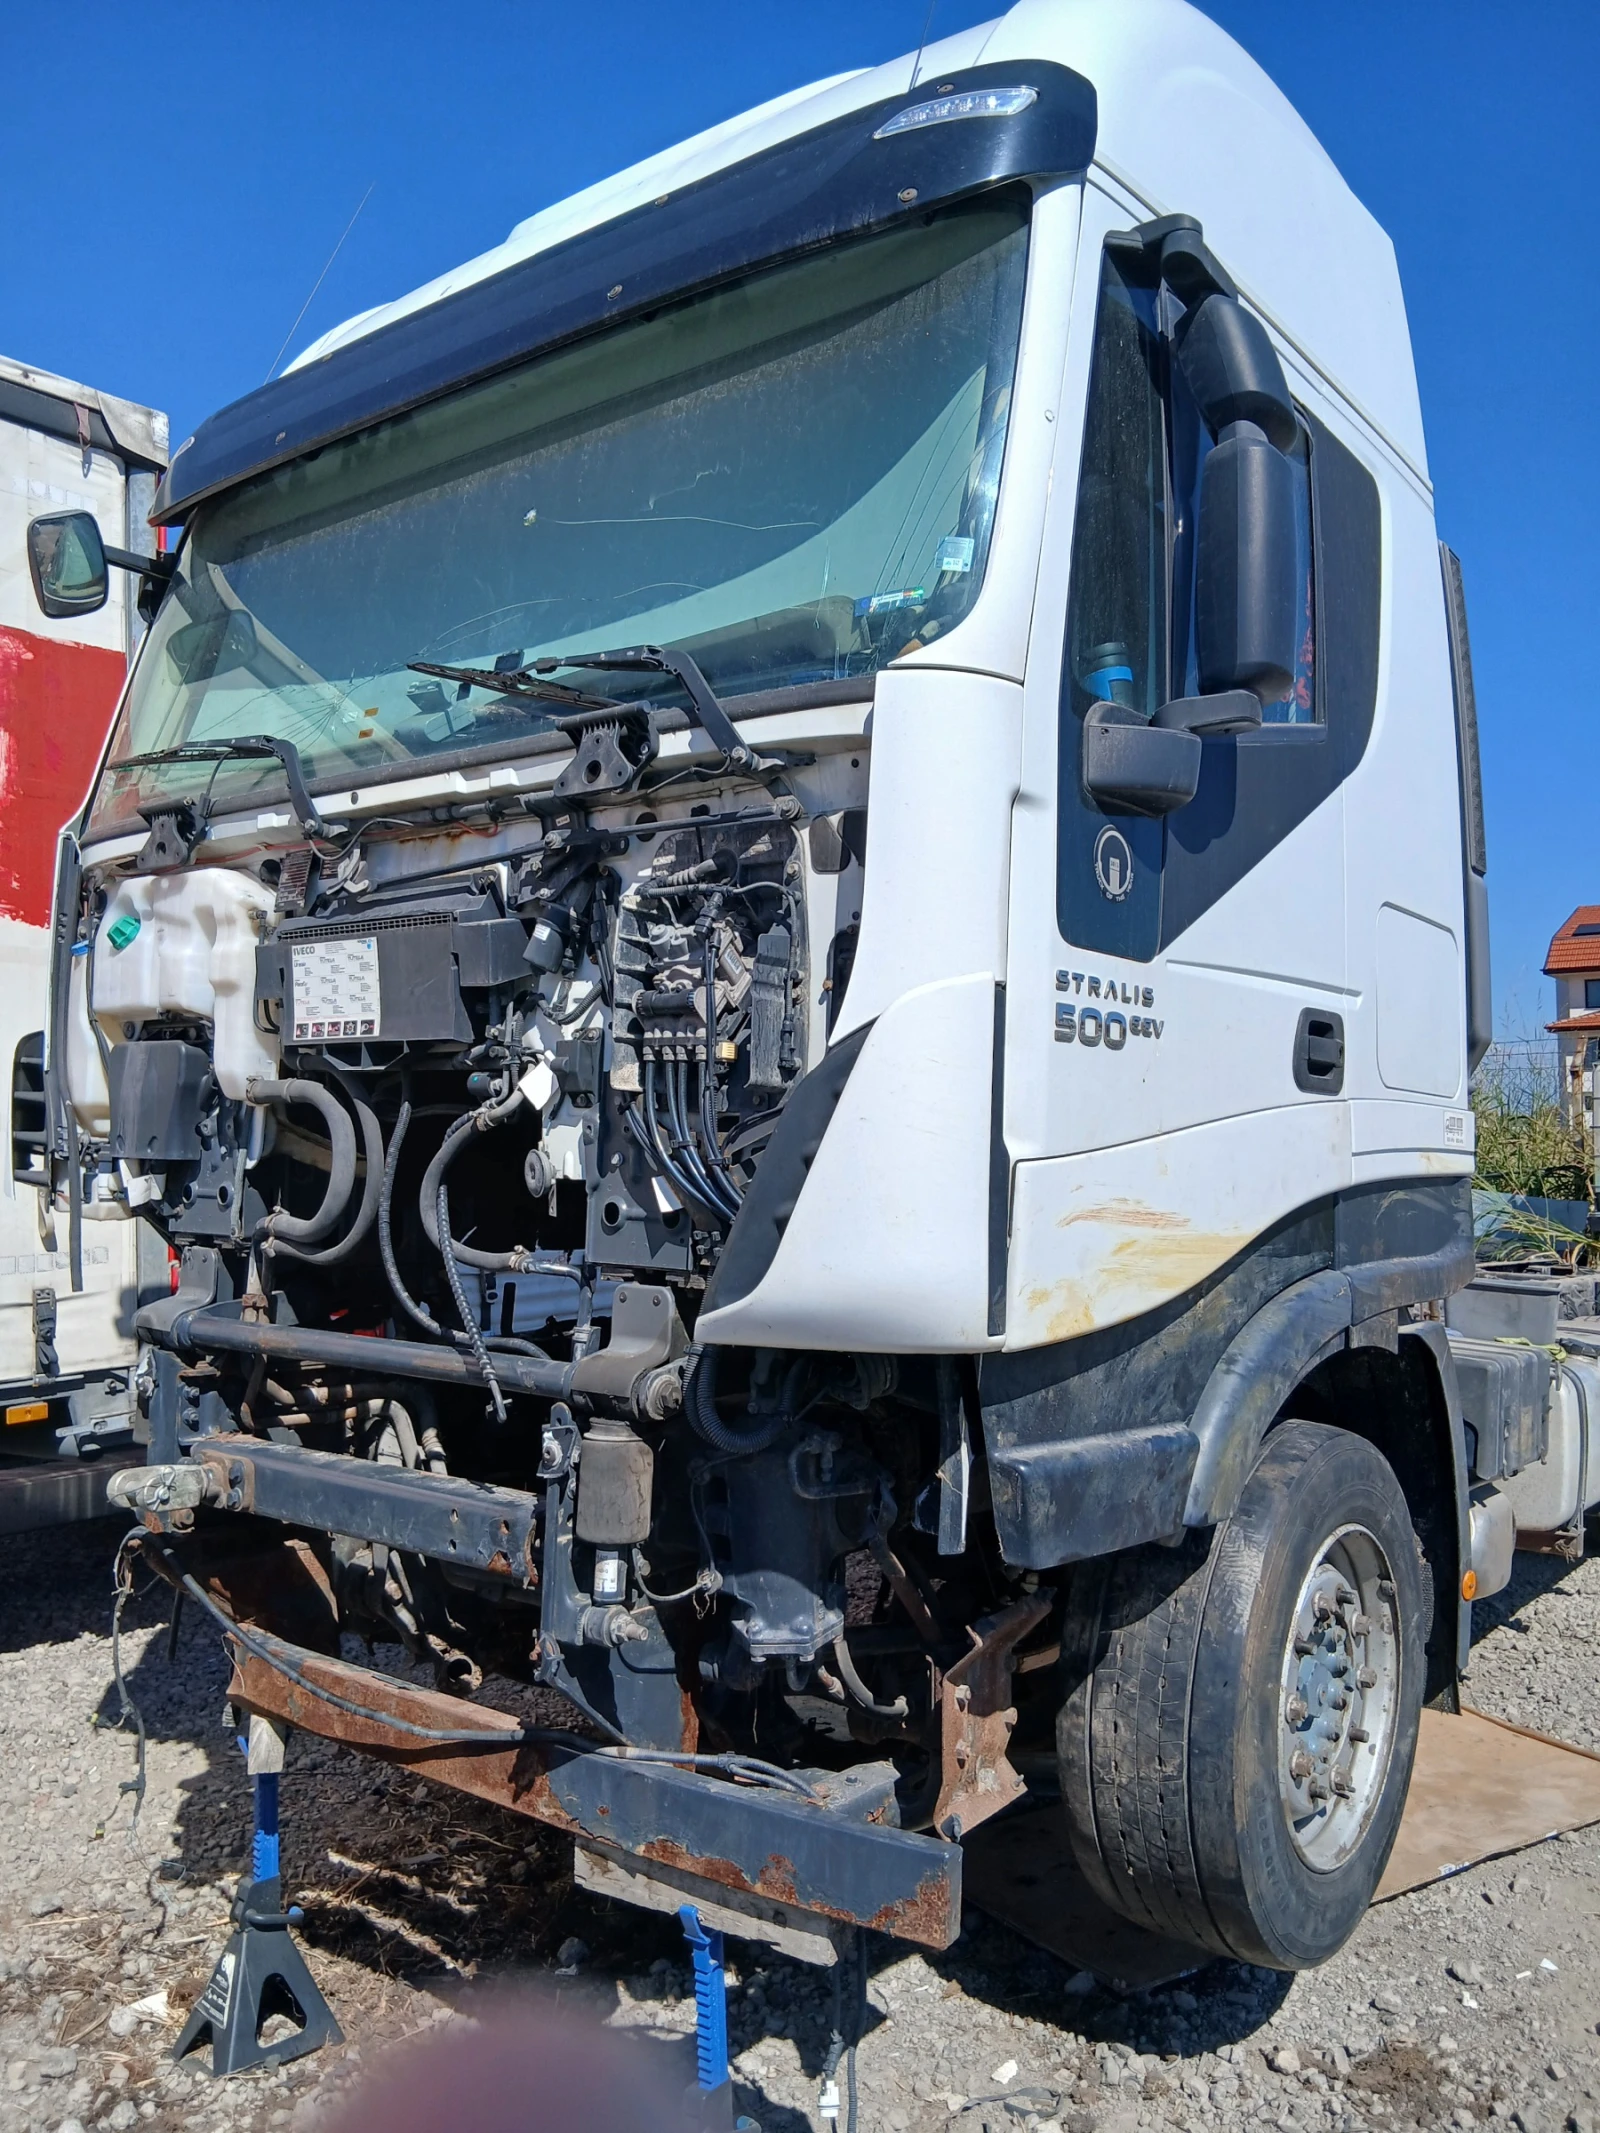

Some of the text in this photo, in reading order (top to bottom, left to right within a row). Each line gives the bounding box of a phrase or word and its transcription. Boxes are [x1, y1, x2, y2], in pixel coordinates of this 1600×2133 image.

[1094, 861, 1105, 891] TRUCK
[1105, 891, 1114, 900] OF
[1115, 893, 1126, 902] THE
[293, 945, 316, 957] IVECO
[1055, 969, 1155, 1008] STRALIS
[1054, 1002, 1165, 1051] 500 EEV
